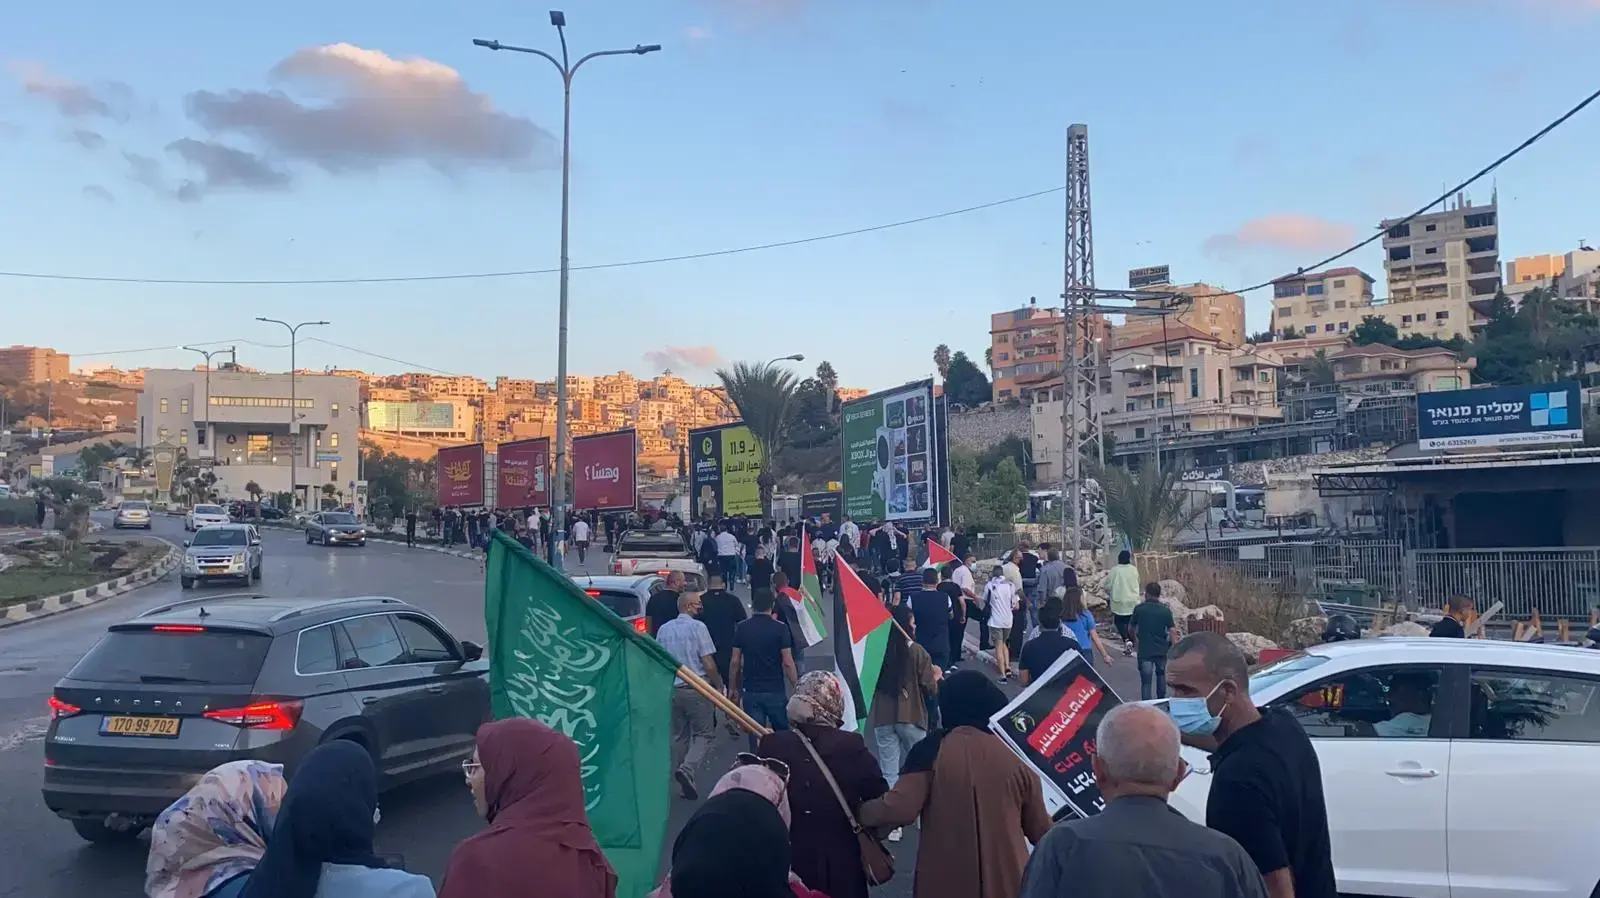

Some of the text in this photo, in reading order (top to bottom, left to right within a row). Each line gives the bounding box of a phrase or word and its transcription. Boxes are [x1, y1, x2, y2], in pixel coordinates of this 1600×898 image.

[1427, 401, 1524, 419] עסליה מנואר
[730, 441, 745, 455] 11.9
